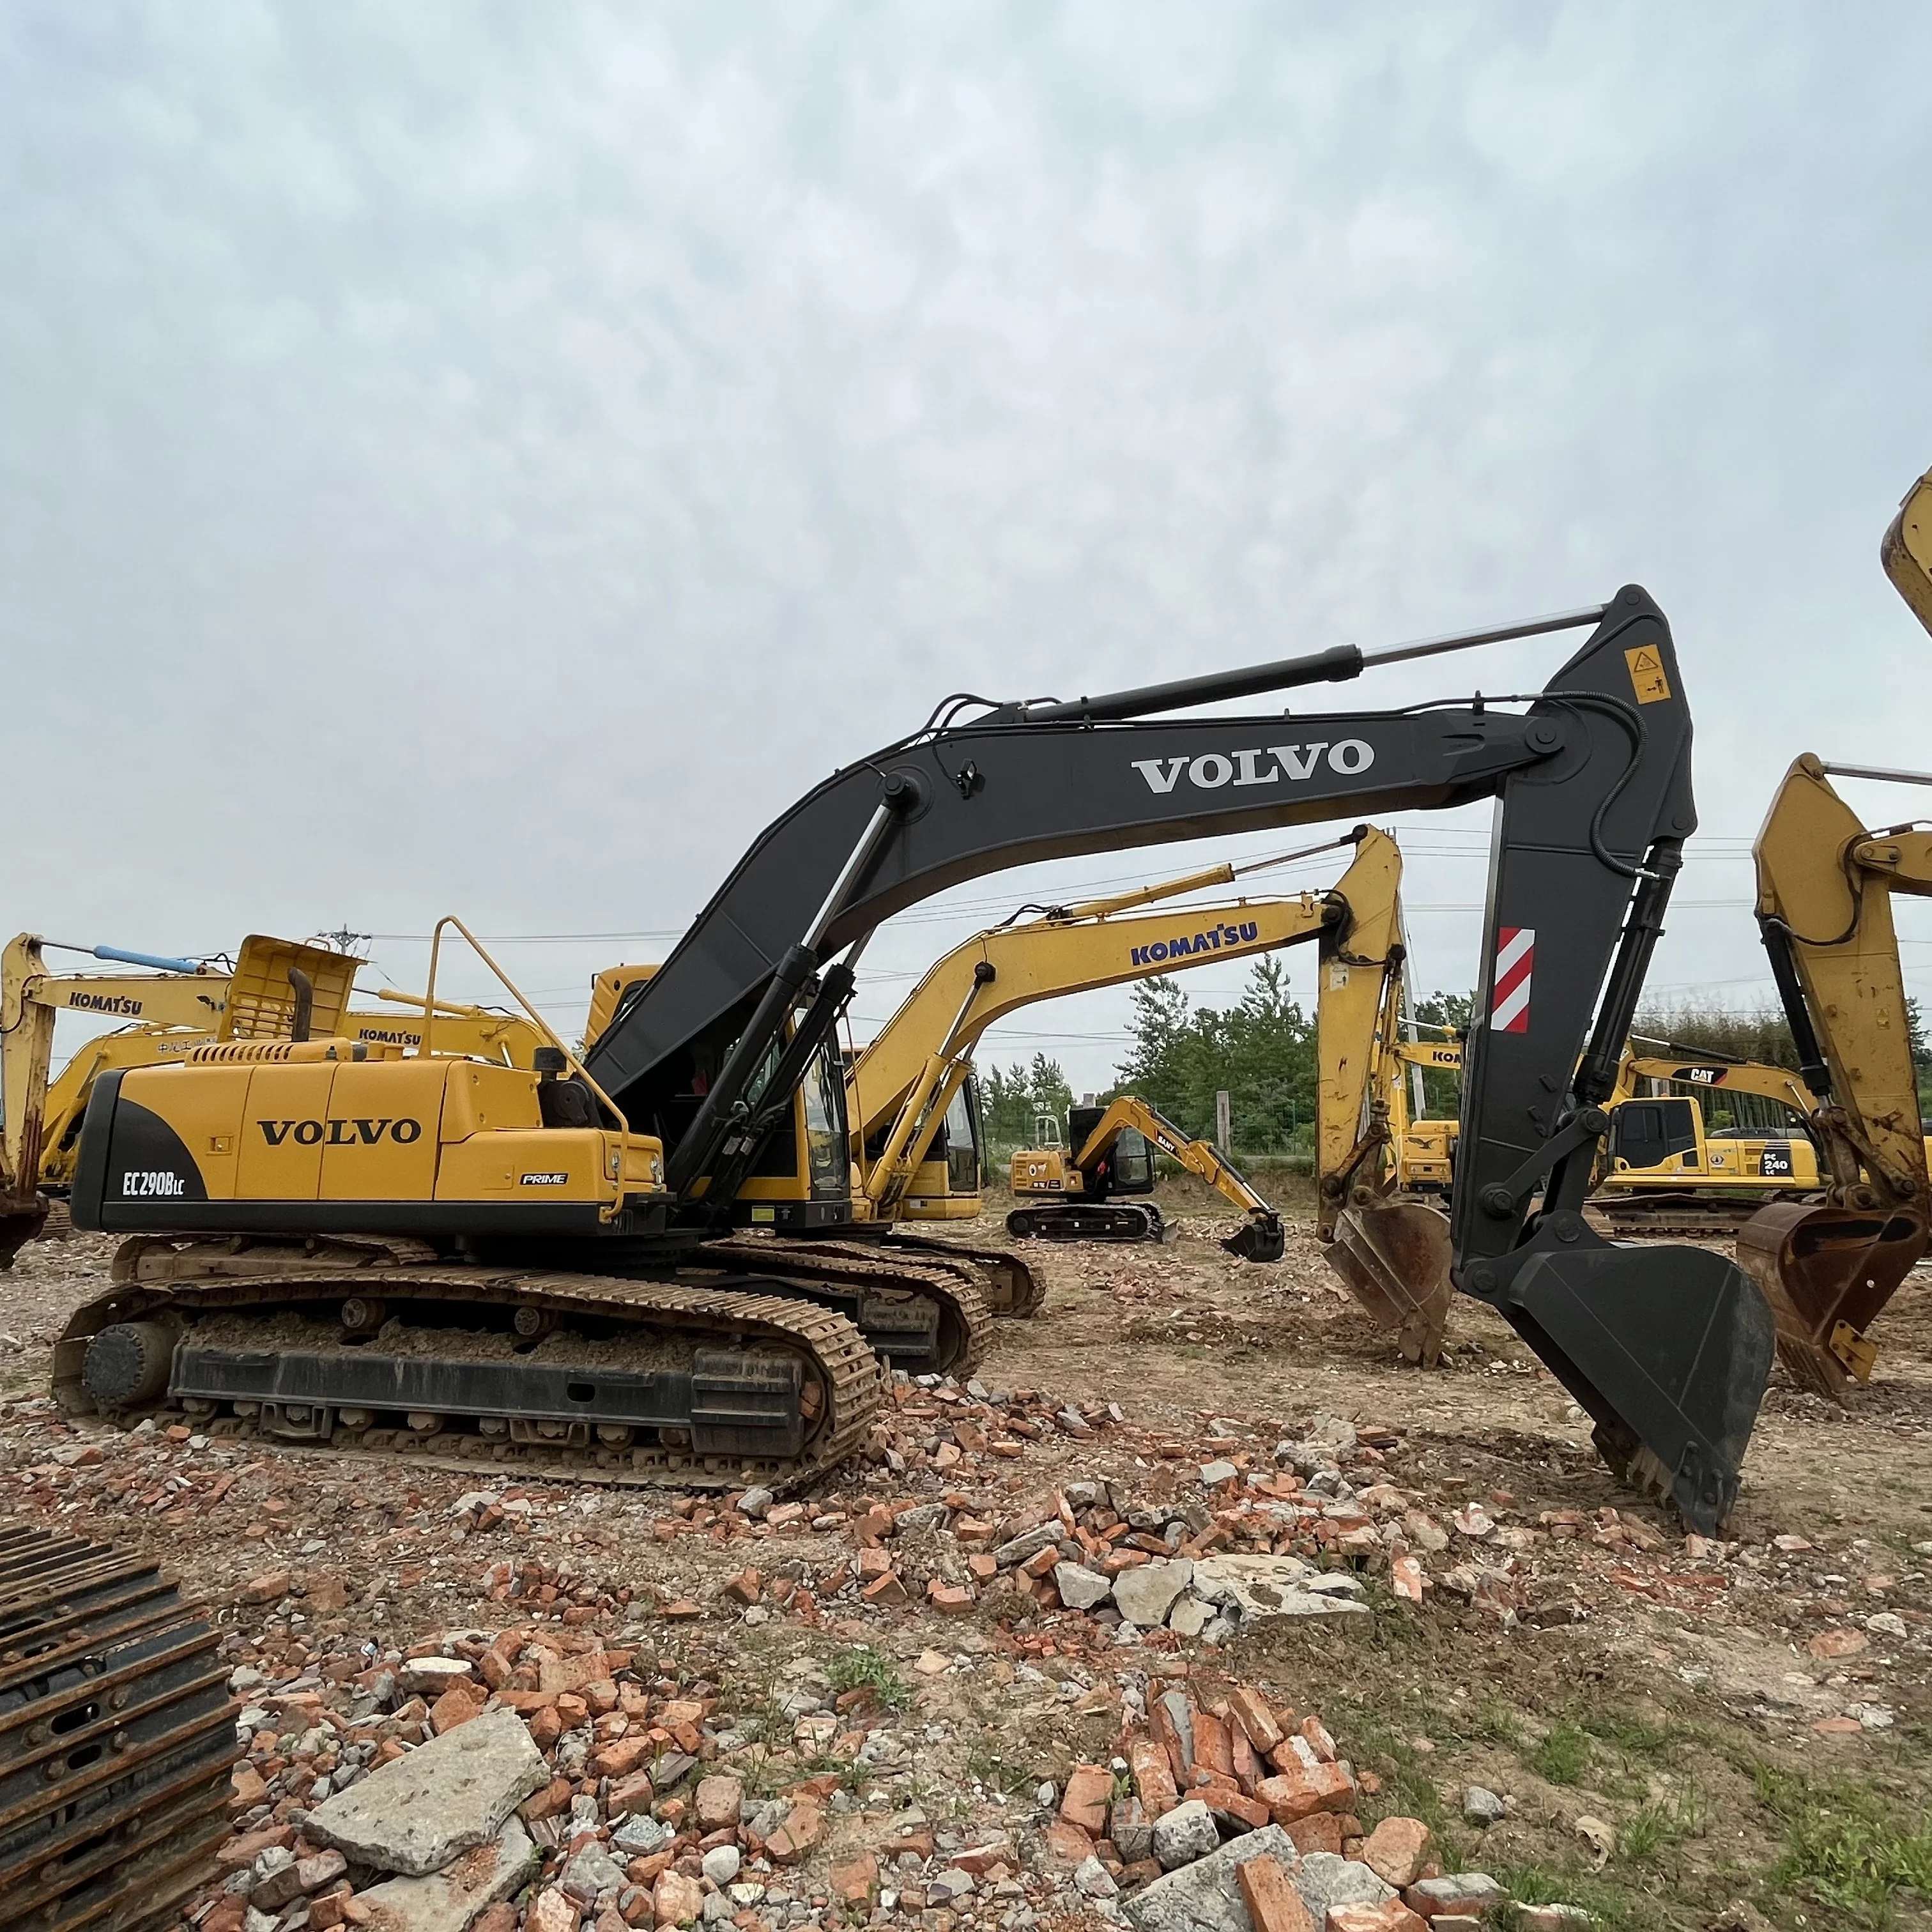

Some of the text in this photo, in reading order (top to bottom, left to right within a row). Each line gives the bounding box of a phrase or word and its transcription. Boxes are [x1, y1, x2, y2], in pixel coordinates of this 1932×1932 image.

[1131, 739, 1375, 793] VOLVO
[1131, 922, 1258, 966] KOMATSU
[69, 992, 143, 1015] KOMATSU
[359, 1028, 421, 1045] KOMATSU
[1690, 1068, 1714, 1083] CAT
[257, 1118, 422, 1146] VOLVO
[1158, 1135, 1176, 1151] SANY
[1764, 1160, 1788, 1170] 240
[523, 1174, 566, 1184] PRIME
